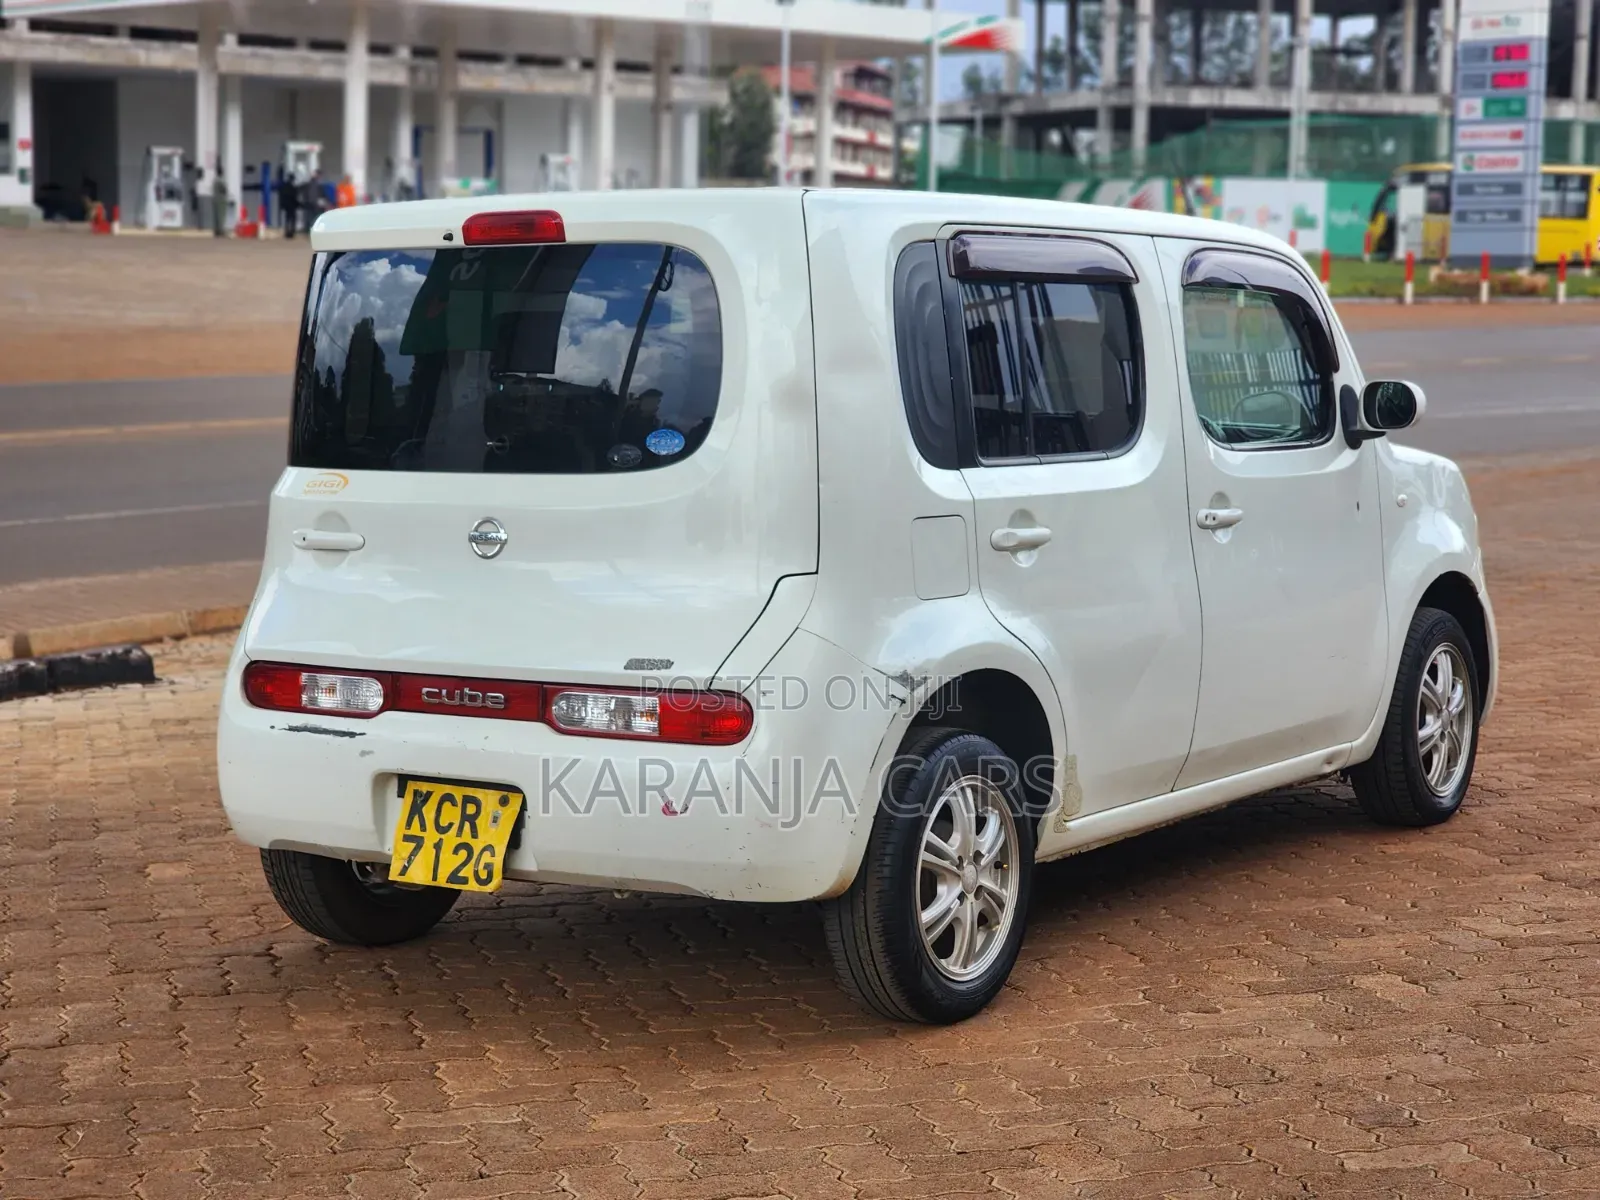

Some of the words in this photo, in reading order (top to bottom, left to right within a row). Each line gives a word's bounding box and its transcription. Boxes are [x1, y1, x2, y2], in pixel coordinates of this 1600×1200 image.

[421, 687, 505, 709] cube
[405, 789, 483, 840] KCR
[398, 834, 496, 887] 712G
